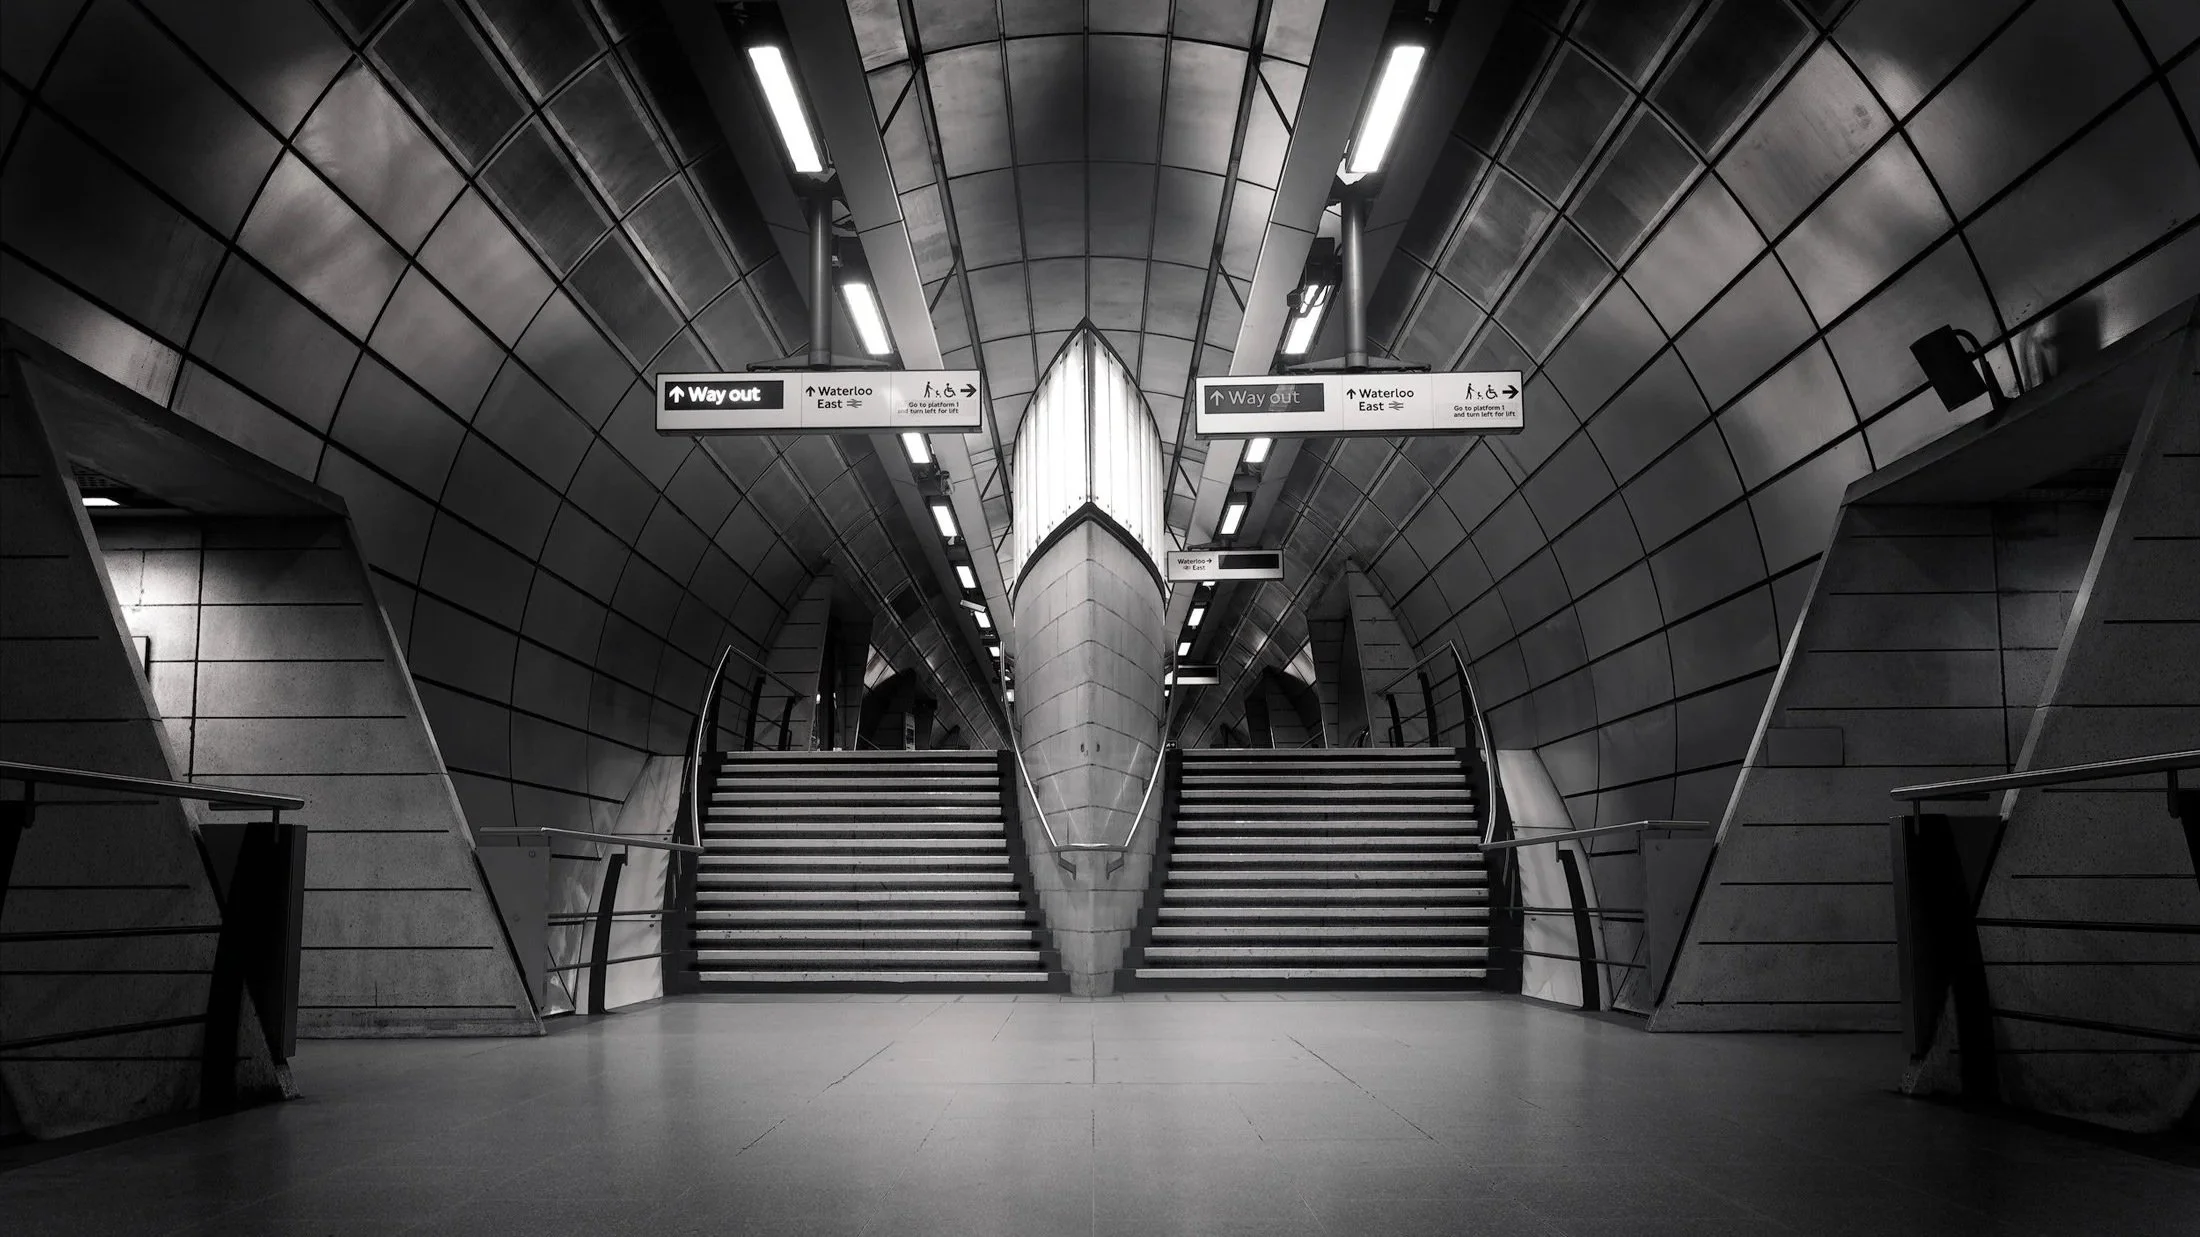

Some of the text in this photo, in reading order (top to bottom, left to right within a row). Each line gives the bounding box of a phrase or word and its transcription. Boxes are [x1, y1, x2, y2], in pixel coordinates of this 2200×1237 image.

[688, 386, 761, 405] Way out
[818, 386, 873, 396] Waterloo
[1359, 388, 1414, 398] Waterloo
[1228, 390, 1301, 407] Way out
[817, 399, 843, 409] East
[1359, 401, 1385, 411] East
